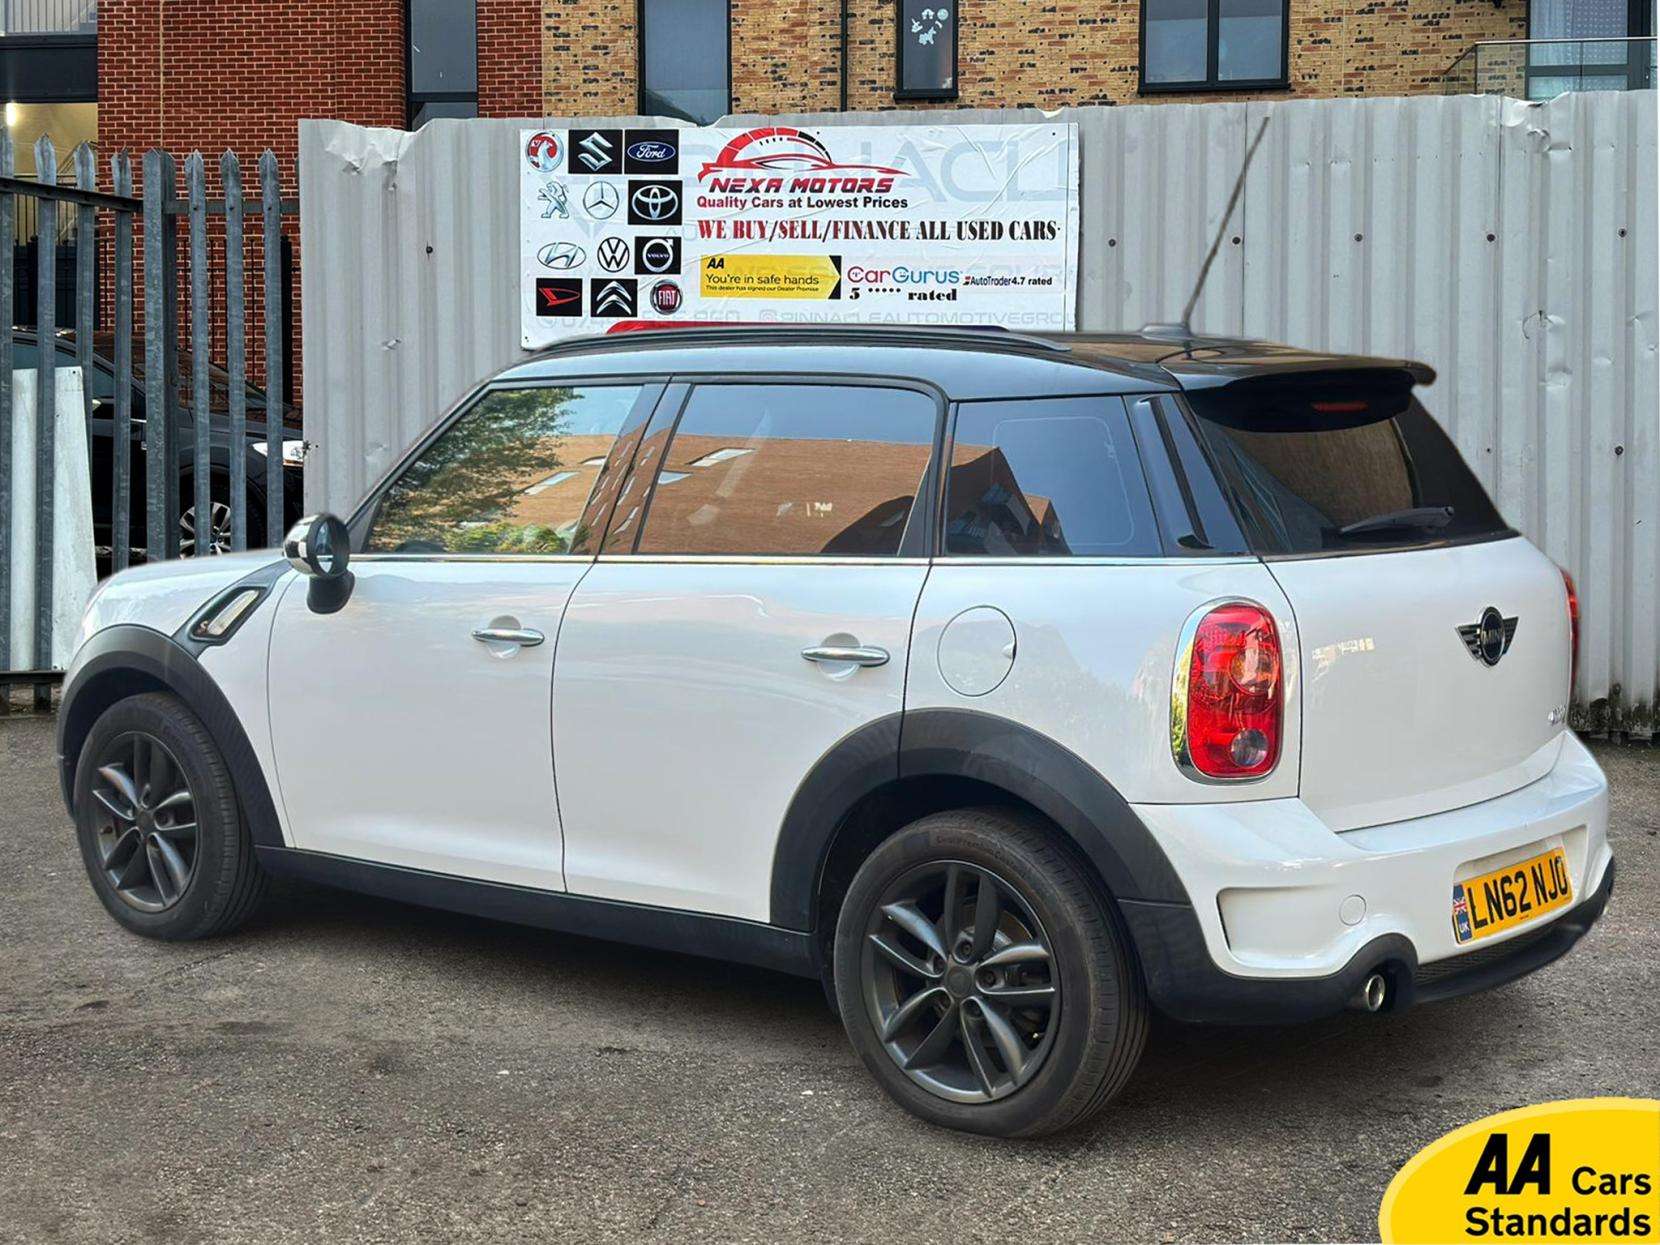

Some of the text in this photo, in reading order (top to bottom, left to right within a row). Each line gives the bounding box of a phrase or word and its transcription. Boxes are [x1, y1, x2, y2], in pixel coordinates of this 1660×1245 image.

[636, 144, 666, 159] Ford
[708, 178, 894, 193] NEXA MOTORS
[697, 196, 908, 210] Quality Cars at Lowest Prices
[697, 220, 727, 240] WE
[916, 220, 951, 240] ALL
[957, 220, 1003, 240] USED
[1008, 220, 1057, 241] CARS
[706, 257, 725, 269] AA
[706, 274, 819, 285] You're in safe hands
[847, 266, 960, 284] CarGurus
[1028, 277, 1053, 286] rated
[658, 290, 677, 306] FIAT
[849, 288, 957, 301] 5 rated
[1467, 856, 1568, 929] LN62 NJO
